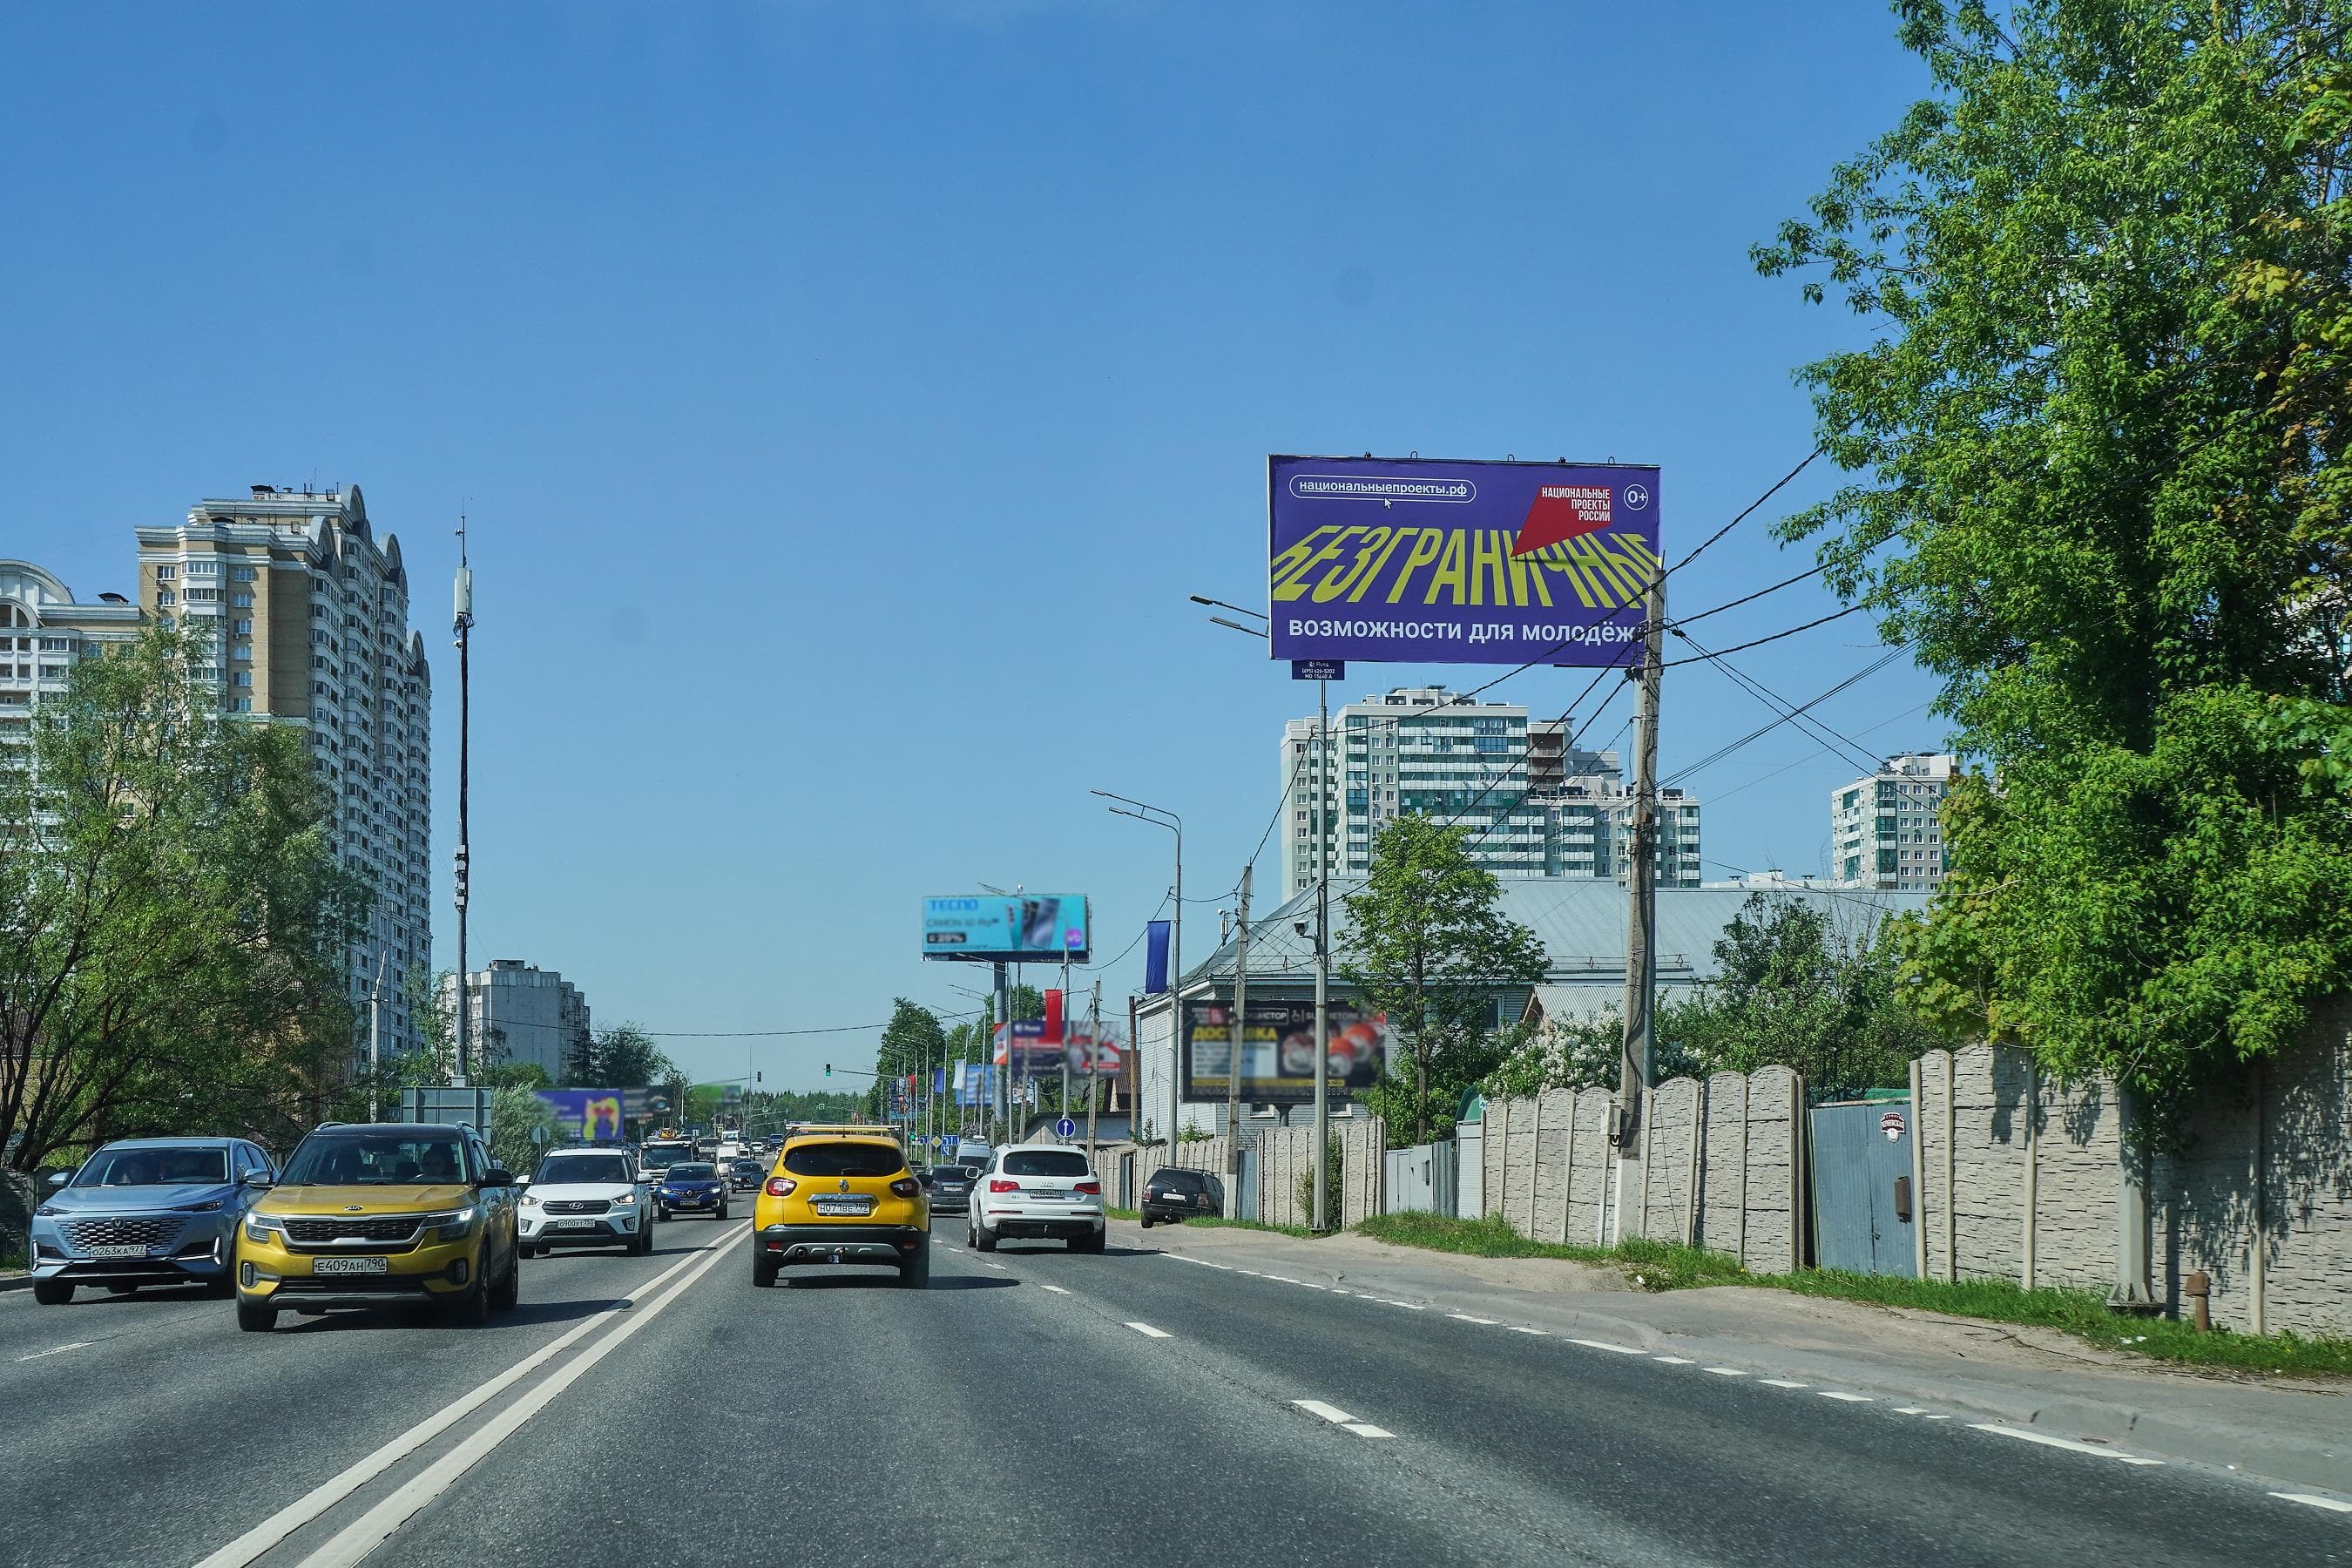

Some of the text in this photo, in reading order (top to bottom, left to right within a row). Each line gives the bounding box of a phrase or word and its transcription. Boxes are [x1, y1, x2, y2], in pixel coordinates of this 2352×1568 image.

[1299, 480, 1468, 497] национальныепроекты.рф
[1542, 486, 1611, 500] НАЦИОНАЛЬНЫЕ
[1571, 498, 1611, 510] ПРОЕКТЫ
[1627, 490, 1647, 504] 0+
[1578, 510, 1611, 522] РОССИИ
[1271, 524, 1662, 608] БЕЗГРАНИЧНЫ
[1288, 618, 1645, 646] возможности для молодёж
